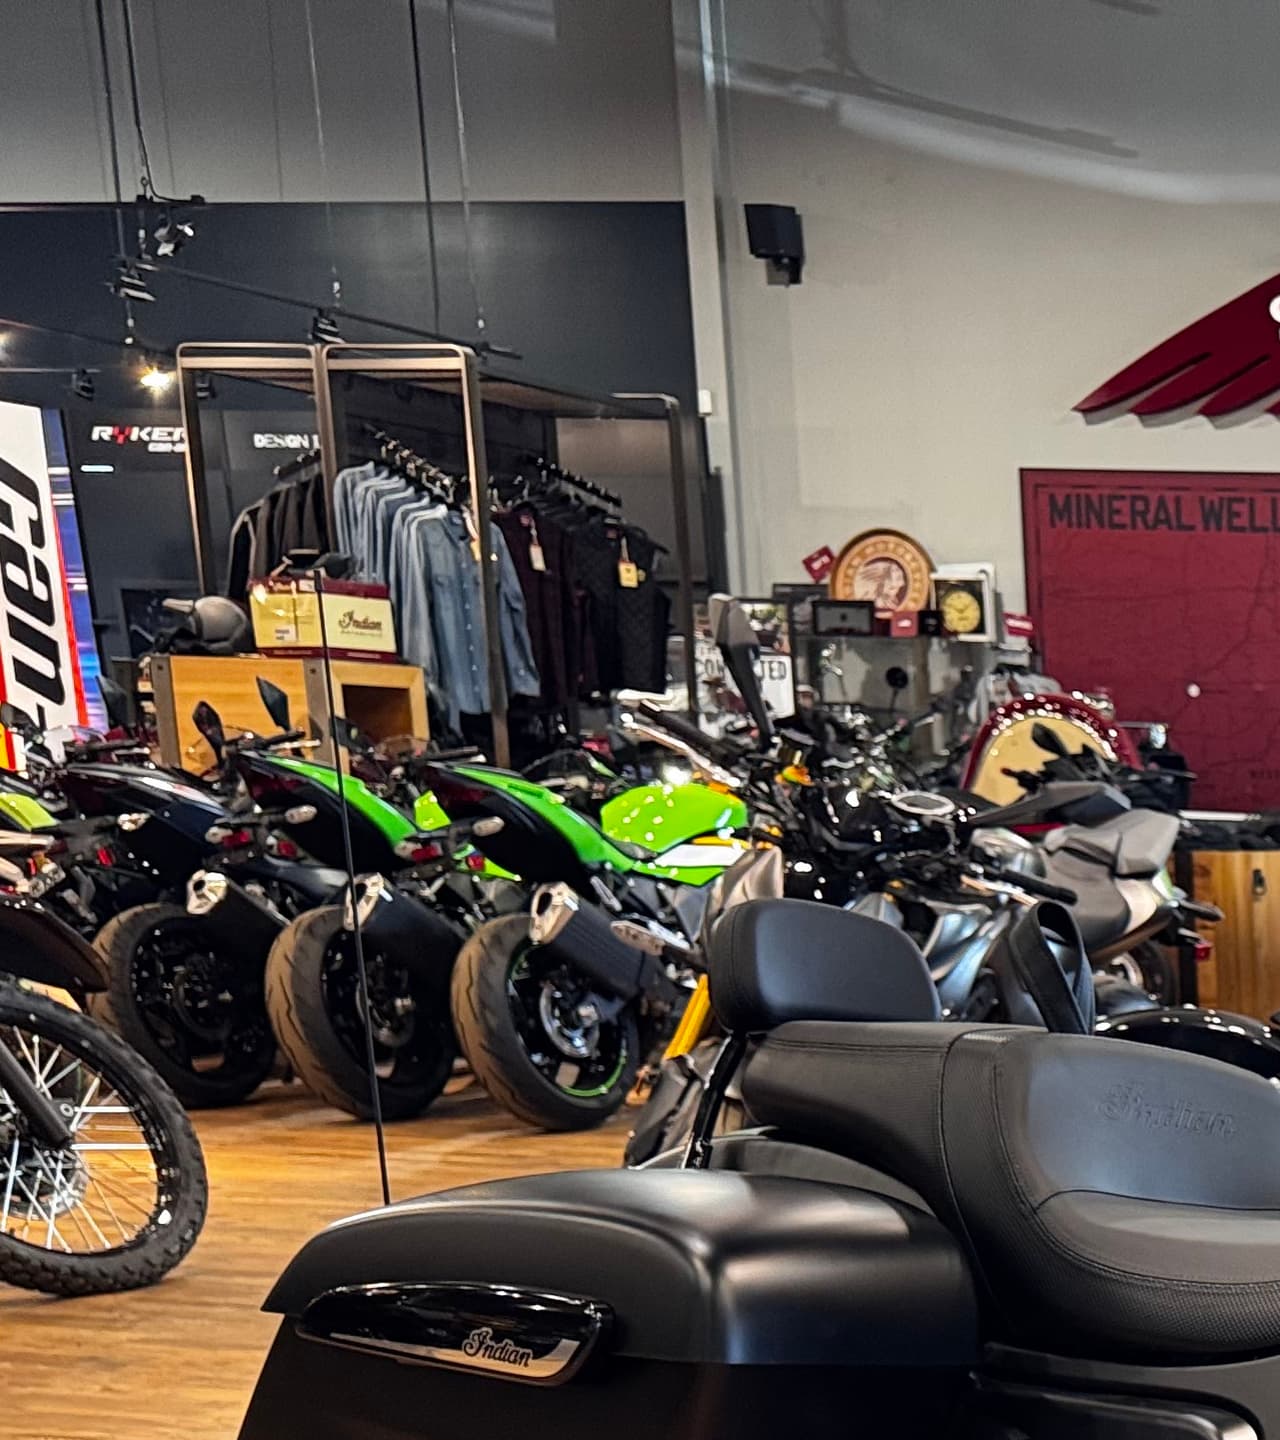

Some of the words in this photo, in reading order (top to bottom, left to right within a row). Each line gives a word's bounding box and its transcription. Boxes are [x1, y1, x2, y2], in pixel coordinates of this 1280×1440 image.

[253, 432, 309, 449] DESIGN
[1050, 493, 1196, 532] MINERAL
[1097, 1080, 1237, 1138] Indian
[462, 1326, 533, 1368] Indian
